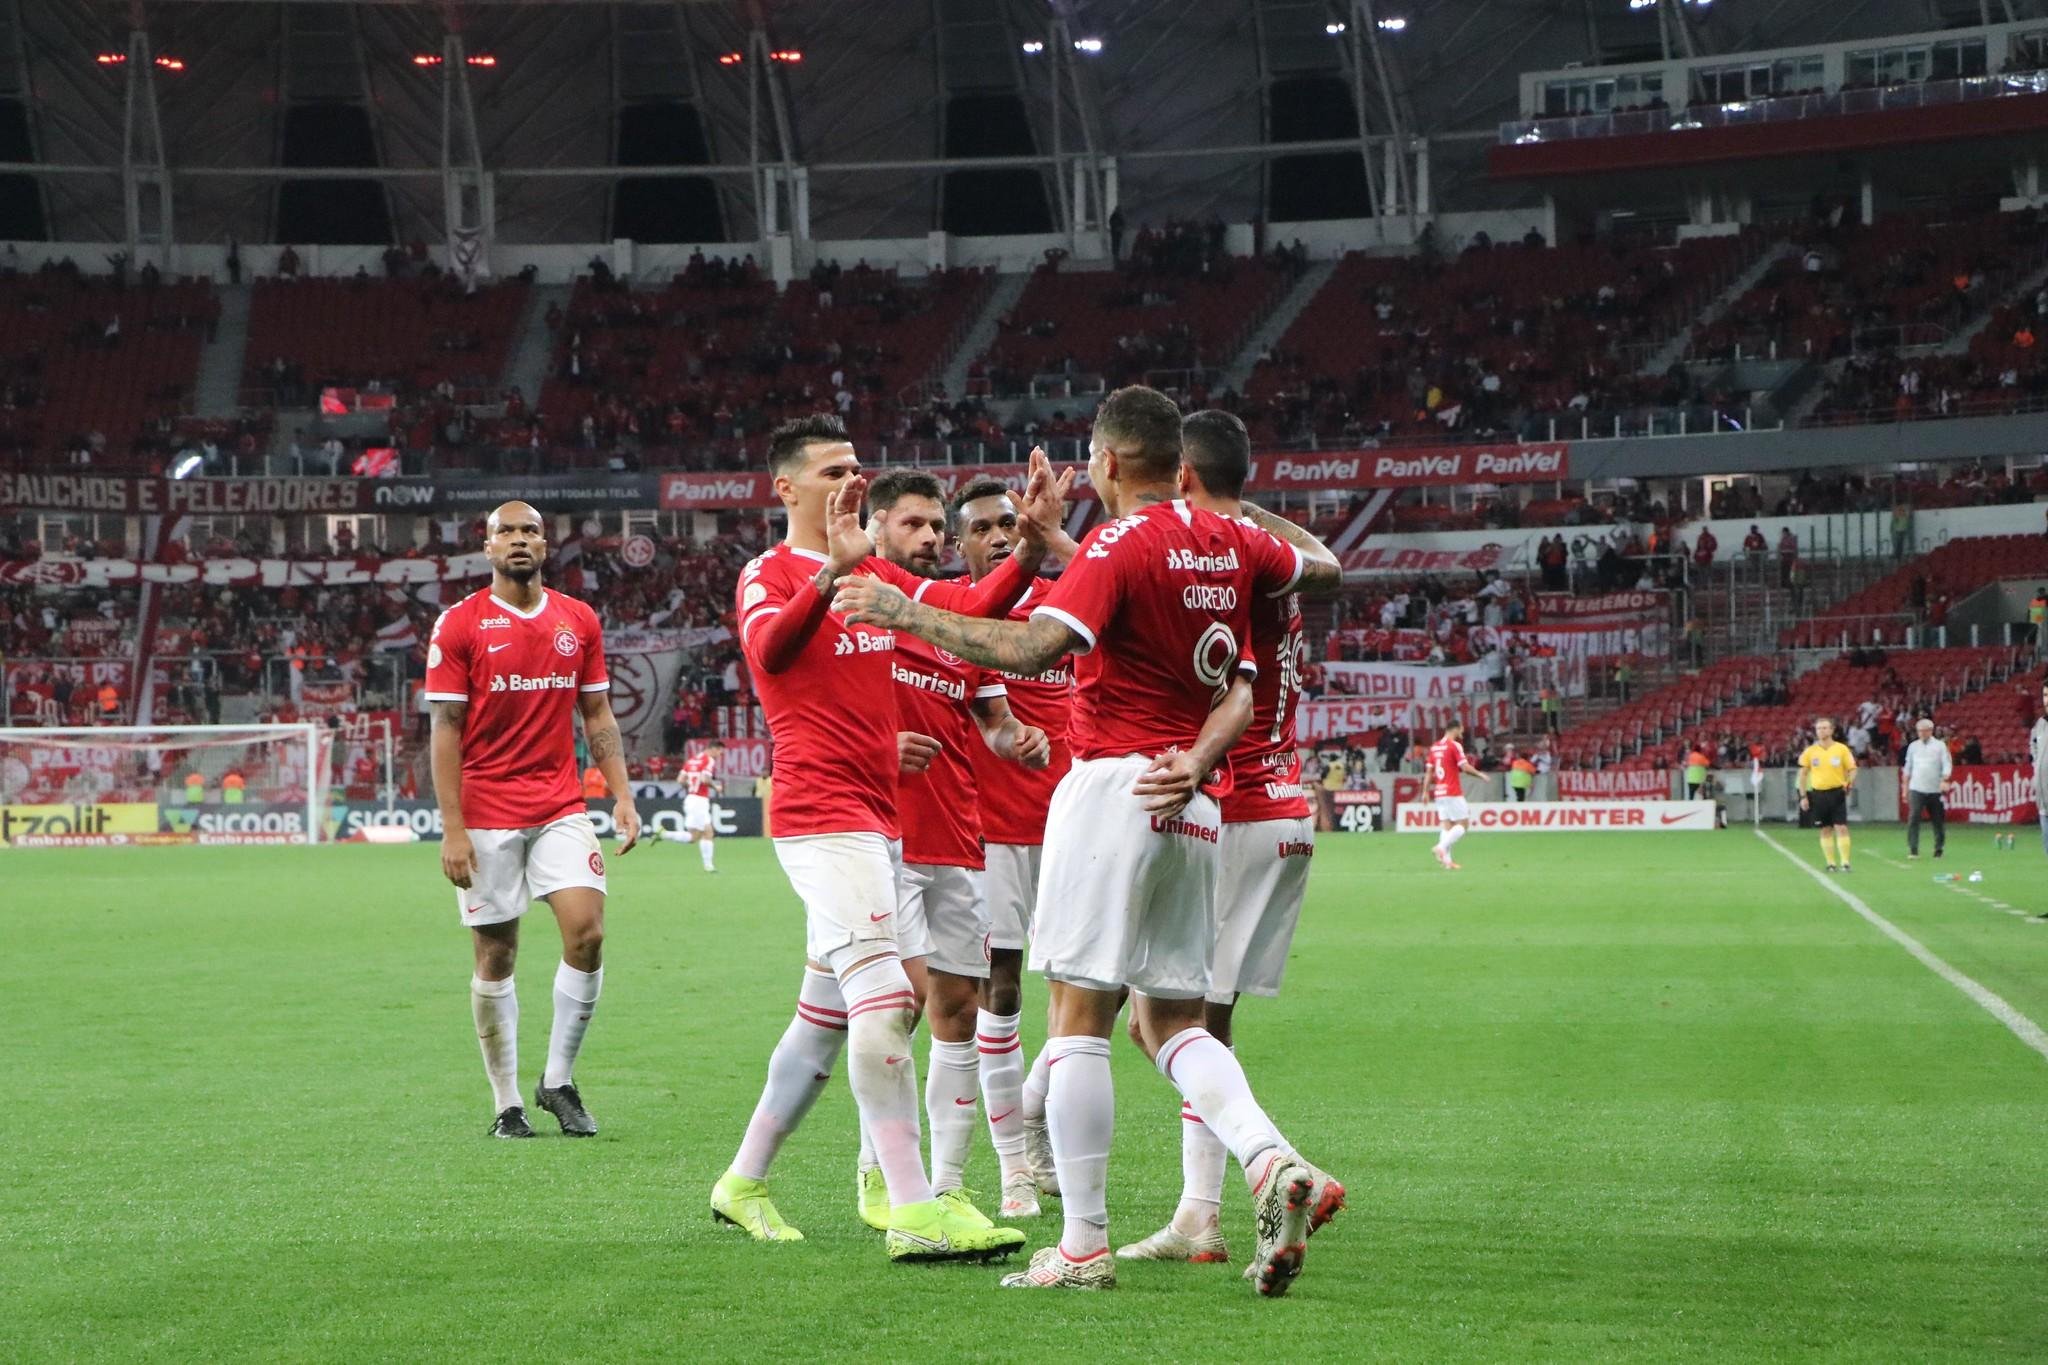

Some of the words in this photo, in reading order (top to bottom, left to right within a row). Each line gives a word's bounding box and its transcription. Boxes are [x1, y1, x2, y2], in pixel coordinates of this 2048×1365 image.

[1273, 459, 1360, 481] PanVel
[1375, 455, 1461, 478] PanVel
[1475, 451, 1562, 474] PanVel
[138, 479, 157, 511] E
[168, 479, 359, 513] PELEADORES
[667, 479, 756, 500] PanVel
[1194, 620, 1238, 701] 9
[509, 670, 577, 692] Banrisul
[199, 811, 302, 834] SICOOB
[1151, 815, 1218, 844] Unimed
[1405, 808, 1645, 828] NI.COM/INTER
